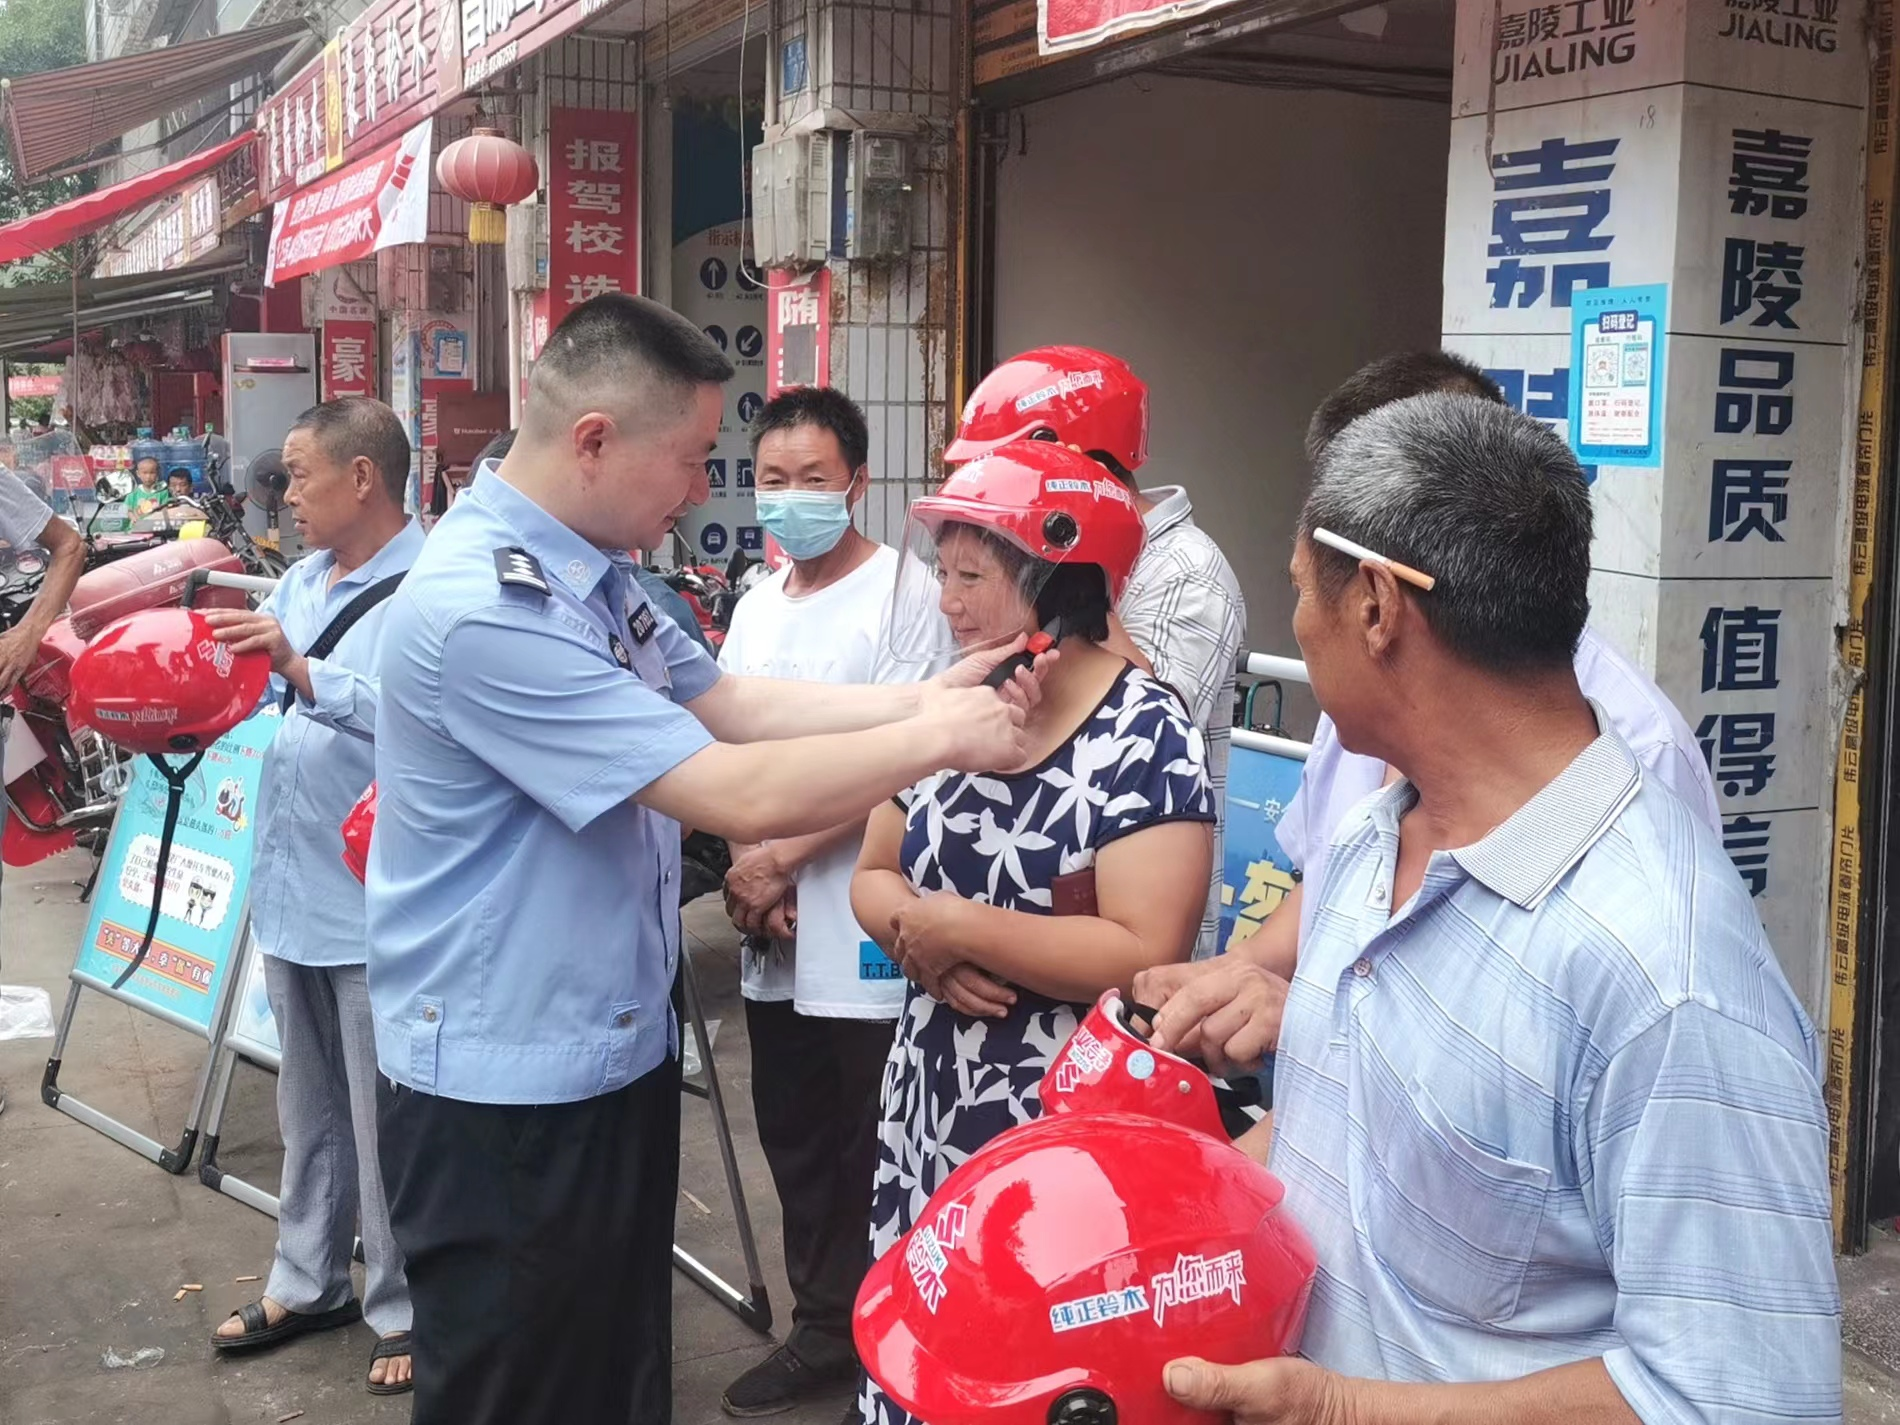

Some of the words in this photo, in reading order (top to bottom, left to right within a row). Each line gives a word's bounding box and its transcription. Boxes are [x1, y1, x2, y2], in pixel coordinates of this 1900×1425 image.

[1498, 0, 1636, 50] 嘉陵工业
[1718, 12, 1837, 53] JIALING
[1495, 31, 1636, 85] JIALING
[565, 138, 625, 255] 报驾校
[1709, 129, 1814, 542] 嘉陵品质
[331, 337, 366, 397] 豪
[1051, 1288, 1148, 1330] 纯正铃木
[1152, 1252, 1247, 1328] 为您而来
